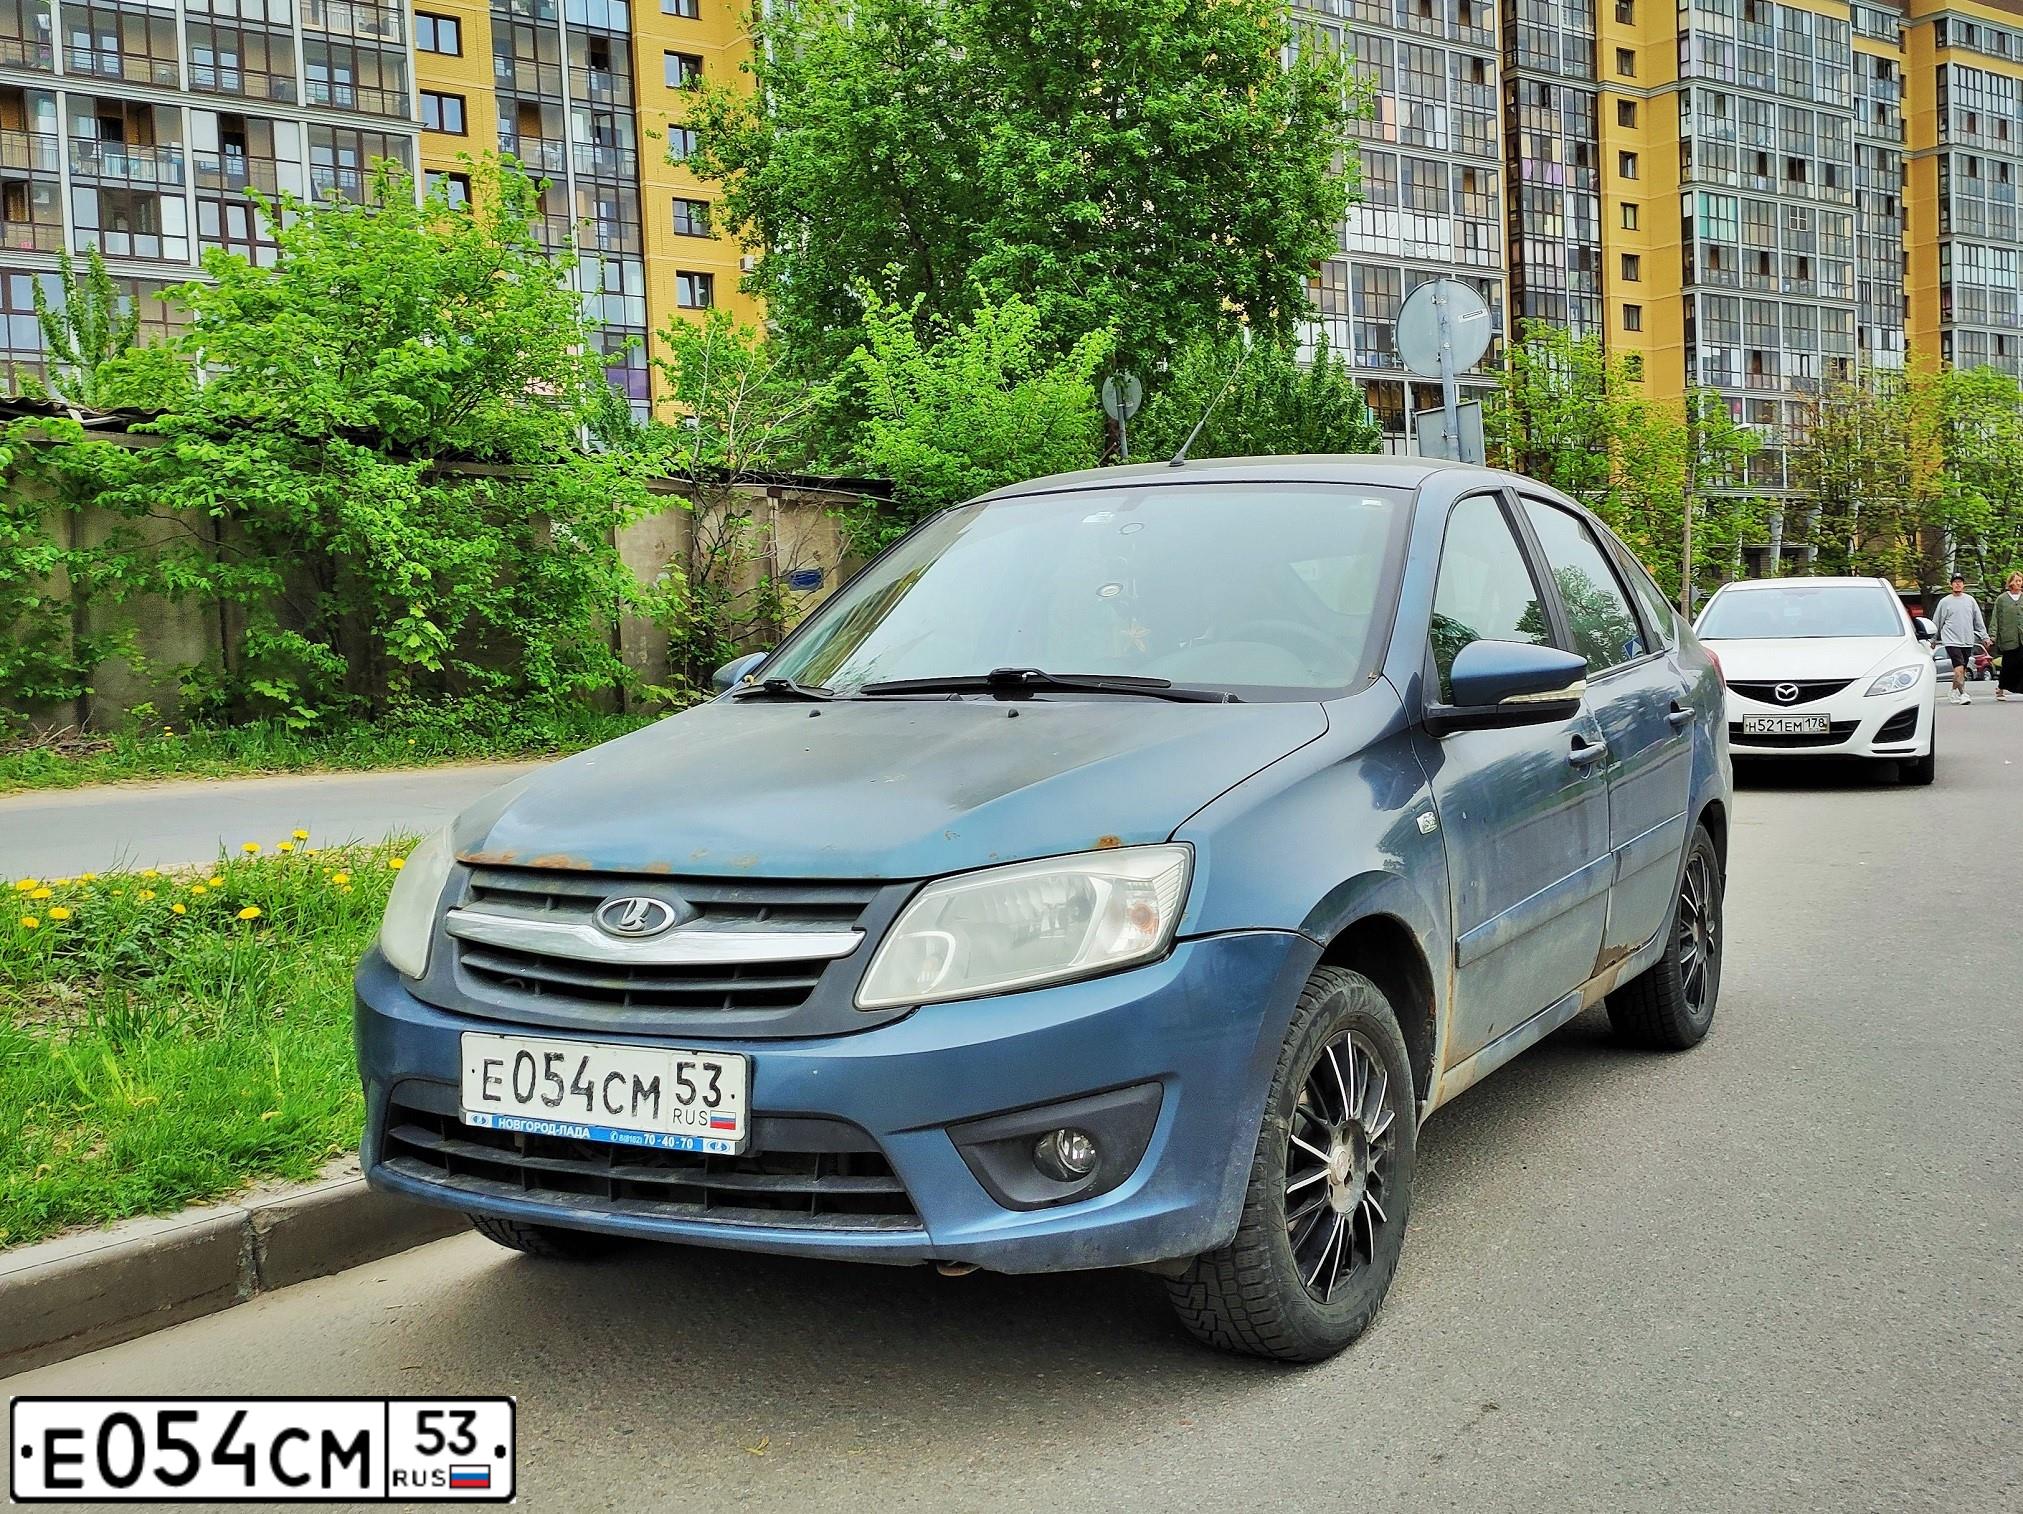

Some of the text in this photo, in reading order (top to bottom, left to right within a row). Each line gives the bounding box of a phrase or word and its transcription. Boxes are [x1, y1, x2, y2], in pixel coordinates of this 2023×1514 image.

[1748, 718, 1825, 732] Н521ЕМ 178
[482, 1049, 722, 1120] Е054СМ 53
[673, 1108, 708, 1126] RUS
[498, 1117, 591, 1139] НОВГОРОД-ЛАДА
